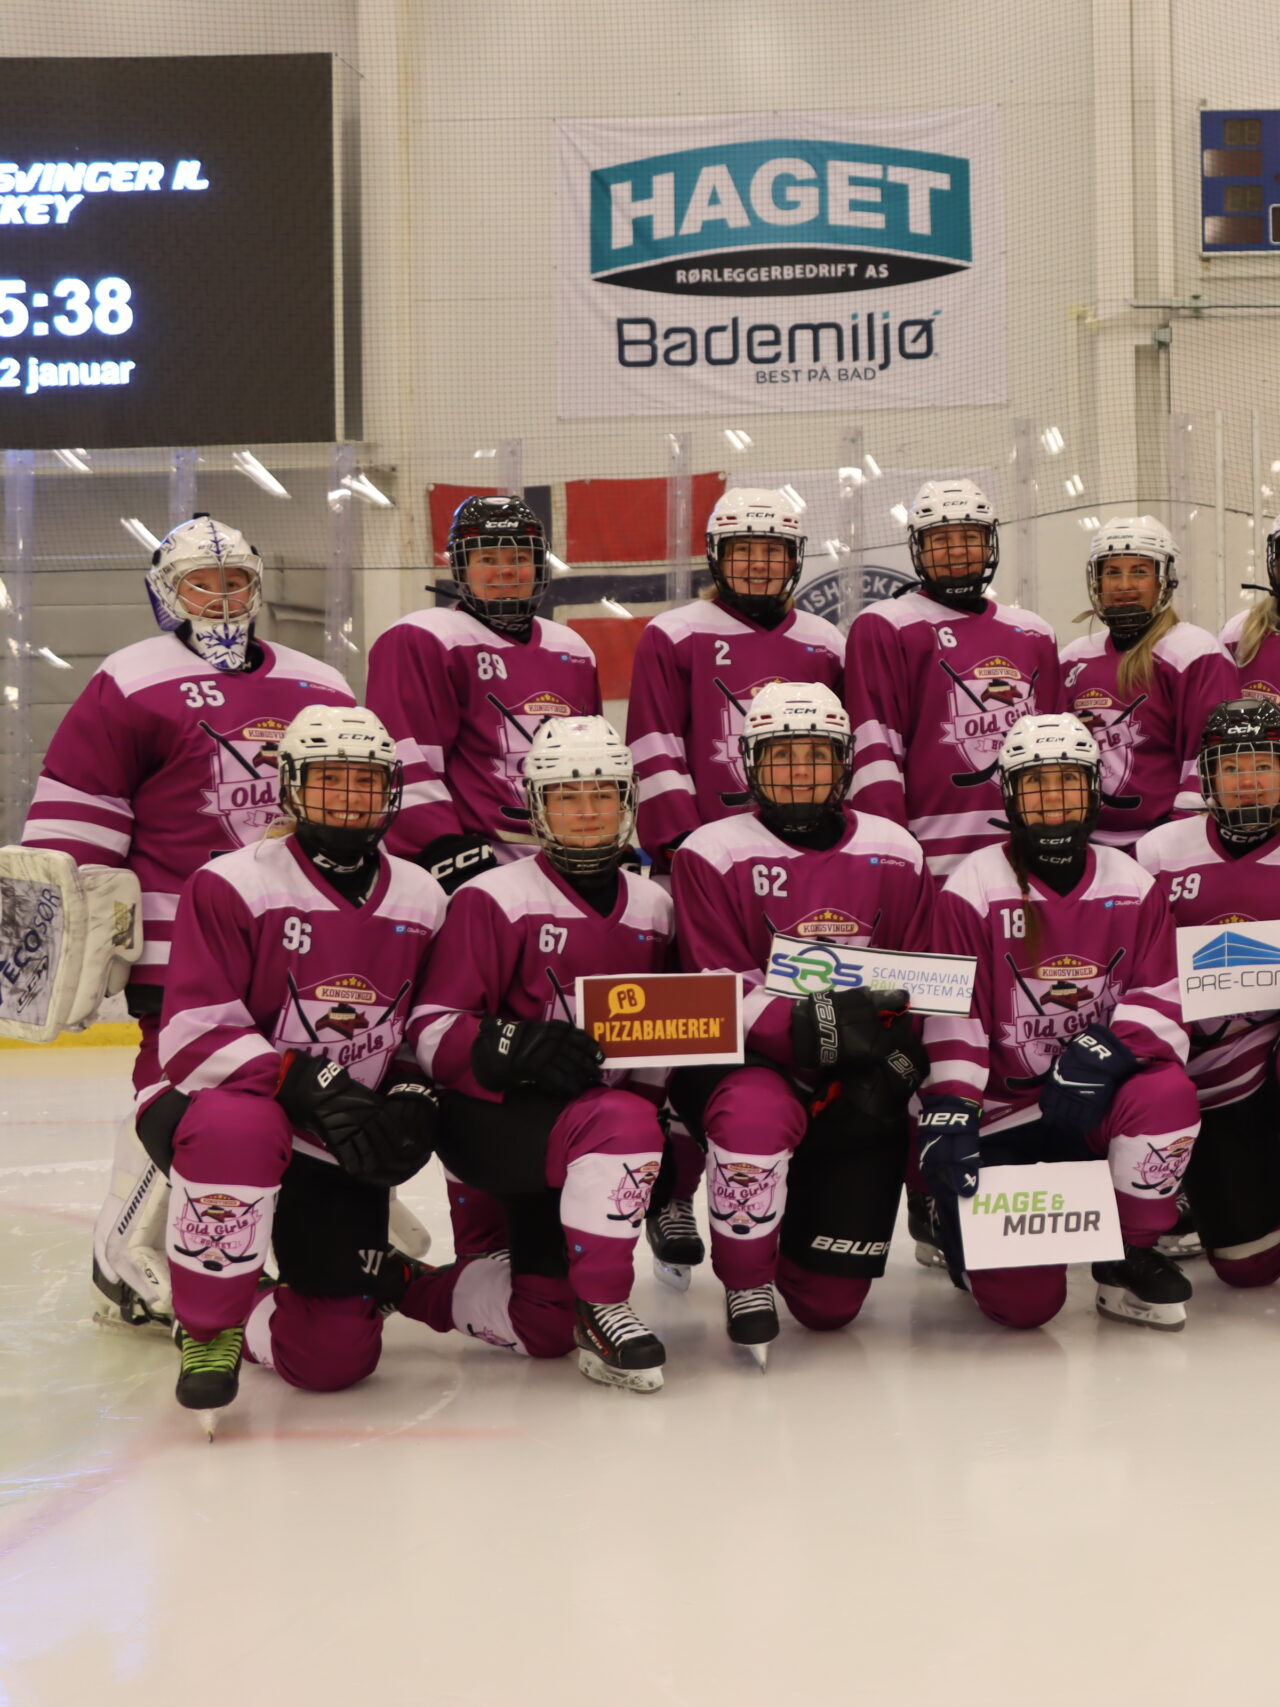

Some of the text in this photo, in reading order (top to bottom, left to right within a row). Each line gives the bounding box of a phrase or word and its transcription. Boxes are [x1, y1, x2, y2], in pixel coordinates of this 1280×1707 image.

[172, 160, 209, 191] IL
[610, 157, 951, 250] HAGET
[676, 263, 889, 284] RØRLEGGERBEDRIFT AS
[616, 310, 943, 371] Bademiljø
[25, 357, 136, 395] januar
[756, 369, 802, 384] BEST
[838, 367, 876, 382] BAD
[943, 500, 969, 508] CCM
[485, 519, 519, 530] CCM
[745, 511, 775, 519] CCM
[945, 585, 974, 594] CCM
[714, 639, 732, 666] 2
[476, 651, 508, 681] 89
[180, 680, 225, 708] 35
[783, 707, 817, 715] CCM
[964, 704, 1034, 737] Old Girl
[247, 728, 287, 740] KONGSVIN
[338, 733, 375, 742] CCM
[1227, 724, 1260, 735] CCM
[1035, 736, 1066, 745] CCM
[231, 785, 277, 809] Old
[1040, 836, 1072, 845] CCM
[1220, 828, 1267, 843] CCM
[1038, 854, 1073, 865] CCM
[752, 864, 788, 897] 62
[1169, 872, 1201, 902] 59
[802, 923, 856, 934] KONGSVINGER
[1000, 908, 1027, 939] 18
[538, 923, 568, 955] 67
[770, 952, 865, 989] SRS
[872, 967, 969, 985] SCANDINAVIAN
[1041, 966, 1094, 978] KONGSVINGER
[320, 986, 373, 1000] KONGSVINGER
[616, 987, 638, 1010] PB
[902, 982, 953, 997] SYSTEM
[956, 986, 973, 999] AS
[593, 1017, 721, 1043] PIZZABAKEREN
[1023, 1002, 1102, 1039] Old Girl
[338, 1032, 385, 1067] Girls
[1149, 1162, 1170, 1173] Old
[117, 1163, 157, 1236] WARRIO
[623, 1189, 644, 1200] Old
[716, 1181, 769, 1199] Old Girls
[972, 1190, 1065, 1215] HAGE &
[186, 1218, 249, 1236] Old Girls
[1003, 1210, 1101, 1237] MOTOR
